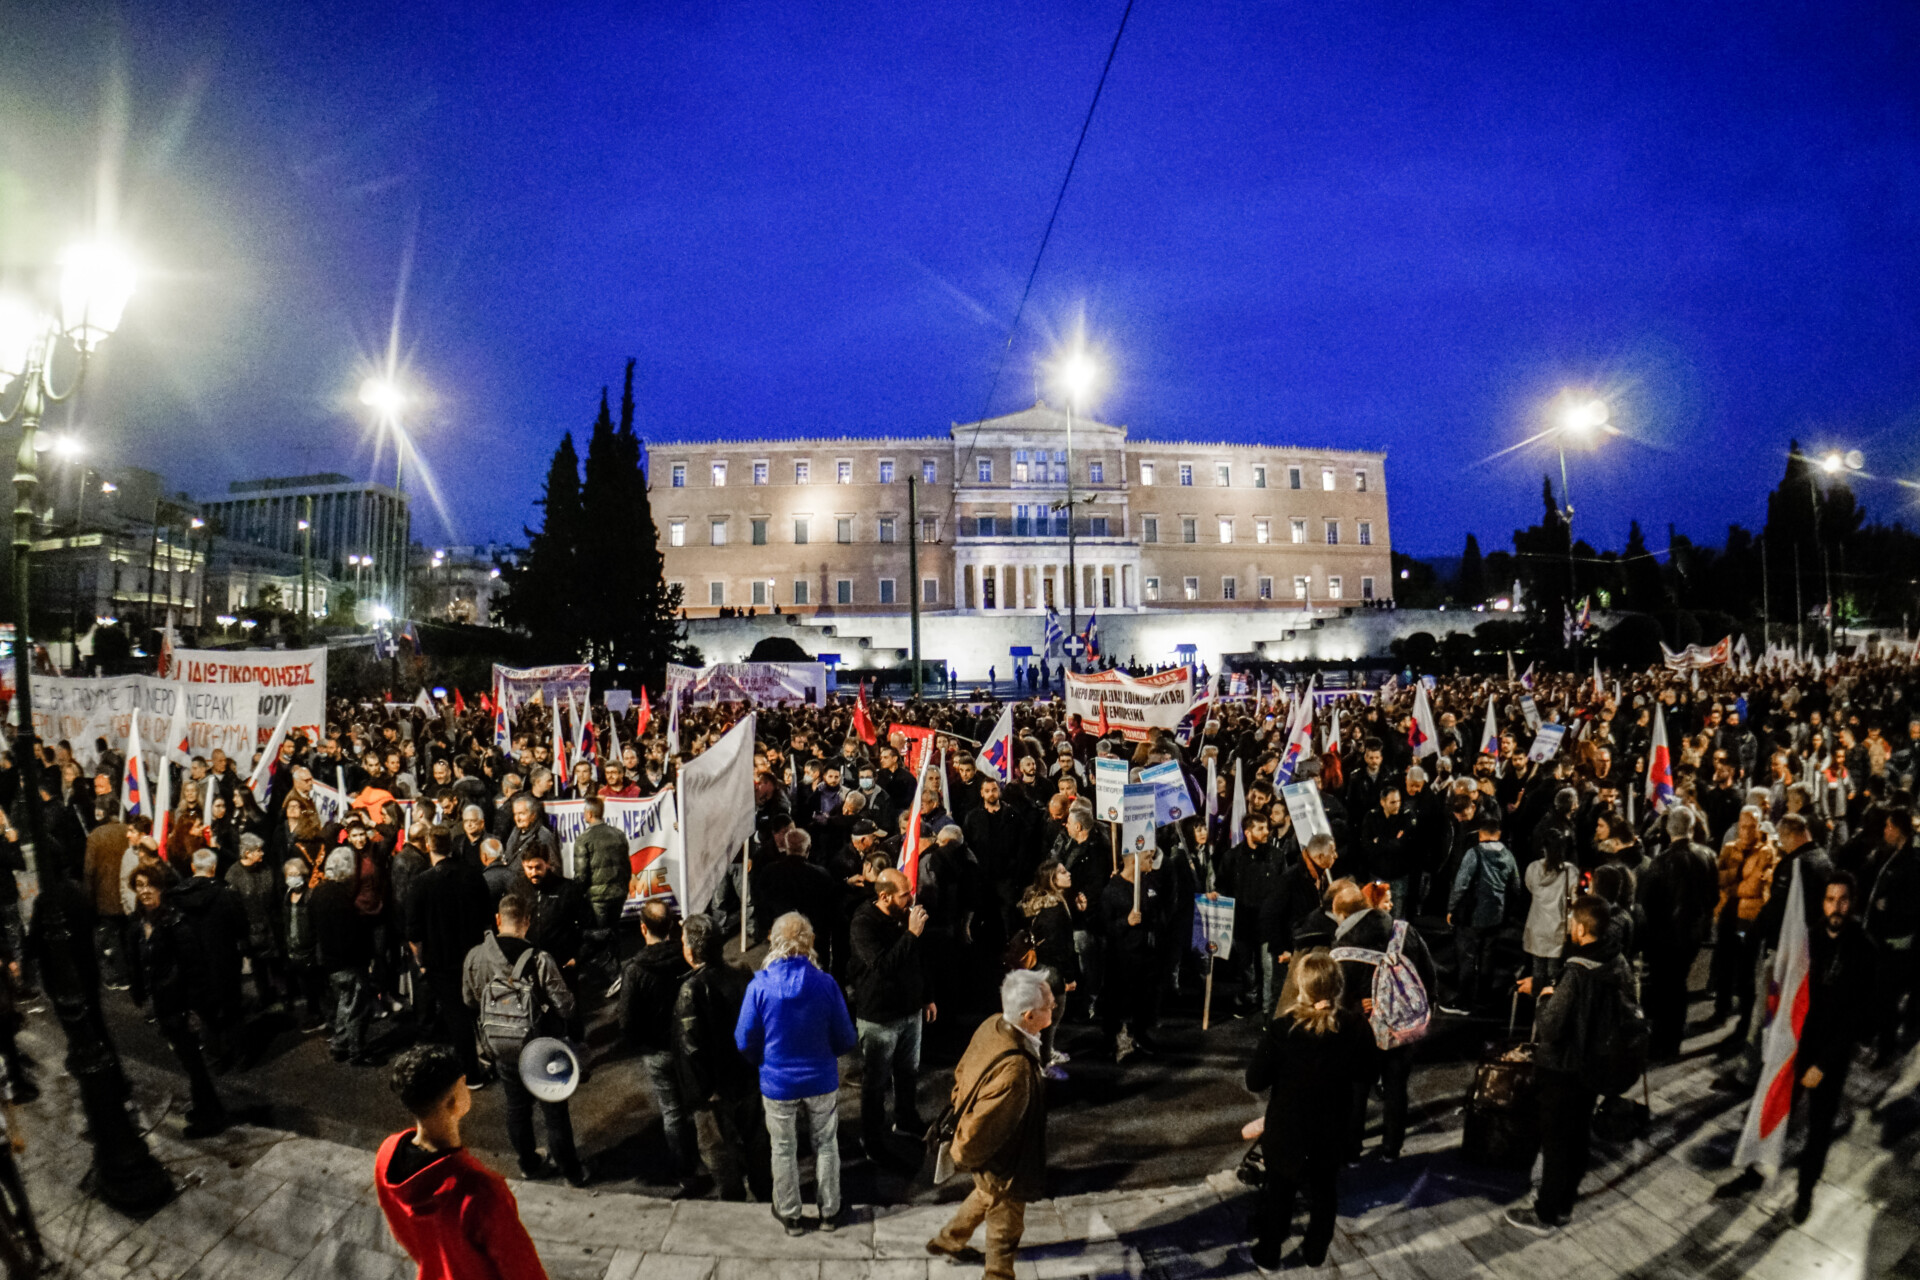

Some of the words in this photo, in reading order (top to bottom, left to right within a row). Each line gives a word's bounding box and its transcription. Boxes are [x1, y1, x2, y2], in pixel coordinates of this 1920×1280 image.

[188, 660, 315, 688] ΙΔΙΩΤΙΚΟΠΟΙΗΣΕΙΣ
[186, 693, 234, 720] ΝΕΡΑΚΙ
[622, 802, 663, 841] ΝΕΡΟΥ
